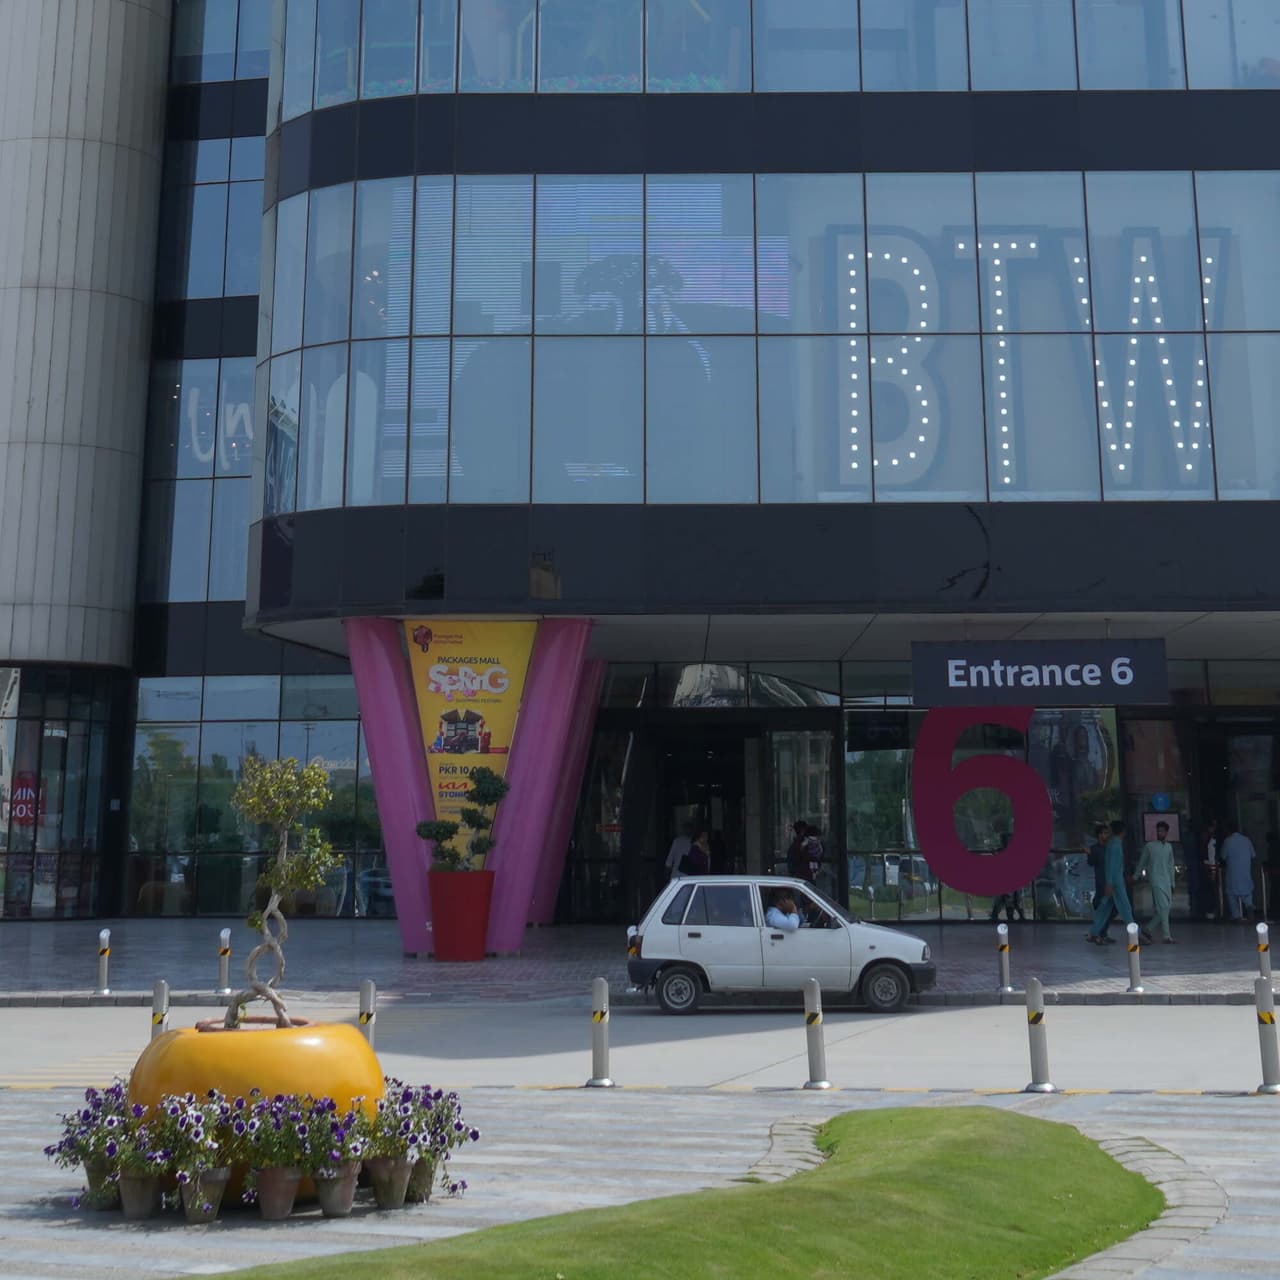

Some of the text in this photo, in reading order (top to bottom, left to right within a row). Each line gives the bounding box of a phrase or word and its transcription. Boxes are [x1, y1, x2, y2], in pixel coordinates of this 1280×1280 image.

[826, 224, 1232, 488] BTW
[437, 656, 501, 665] PACKAGES MALL
[947, 657, 1134, 688] Entrance 6
[439, 765, 457, 775] PKR
[911, 705, 1054, 897] 6
